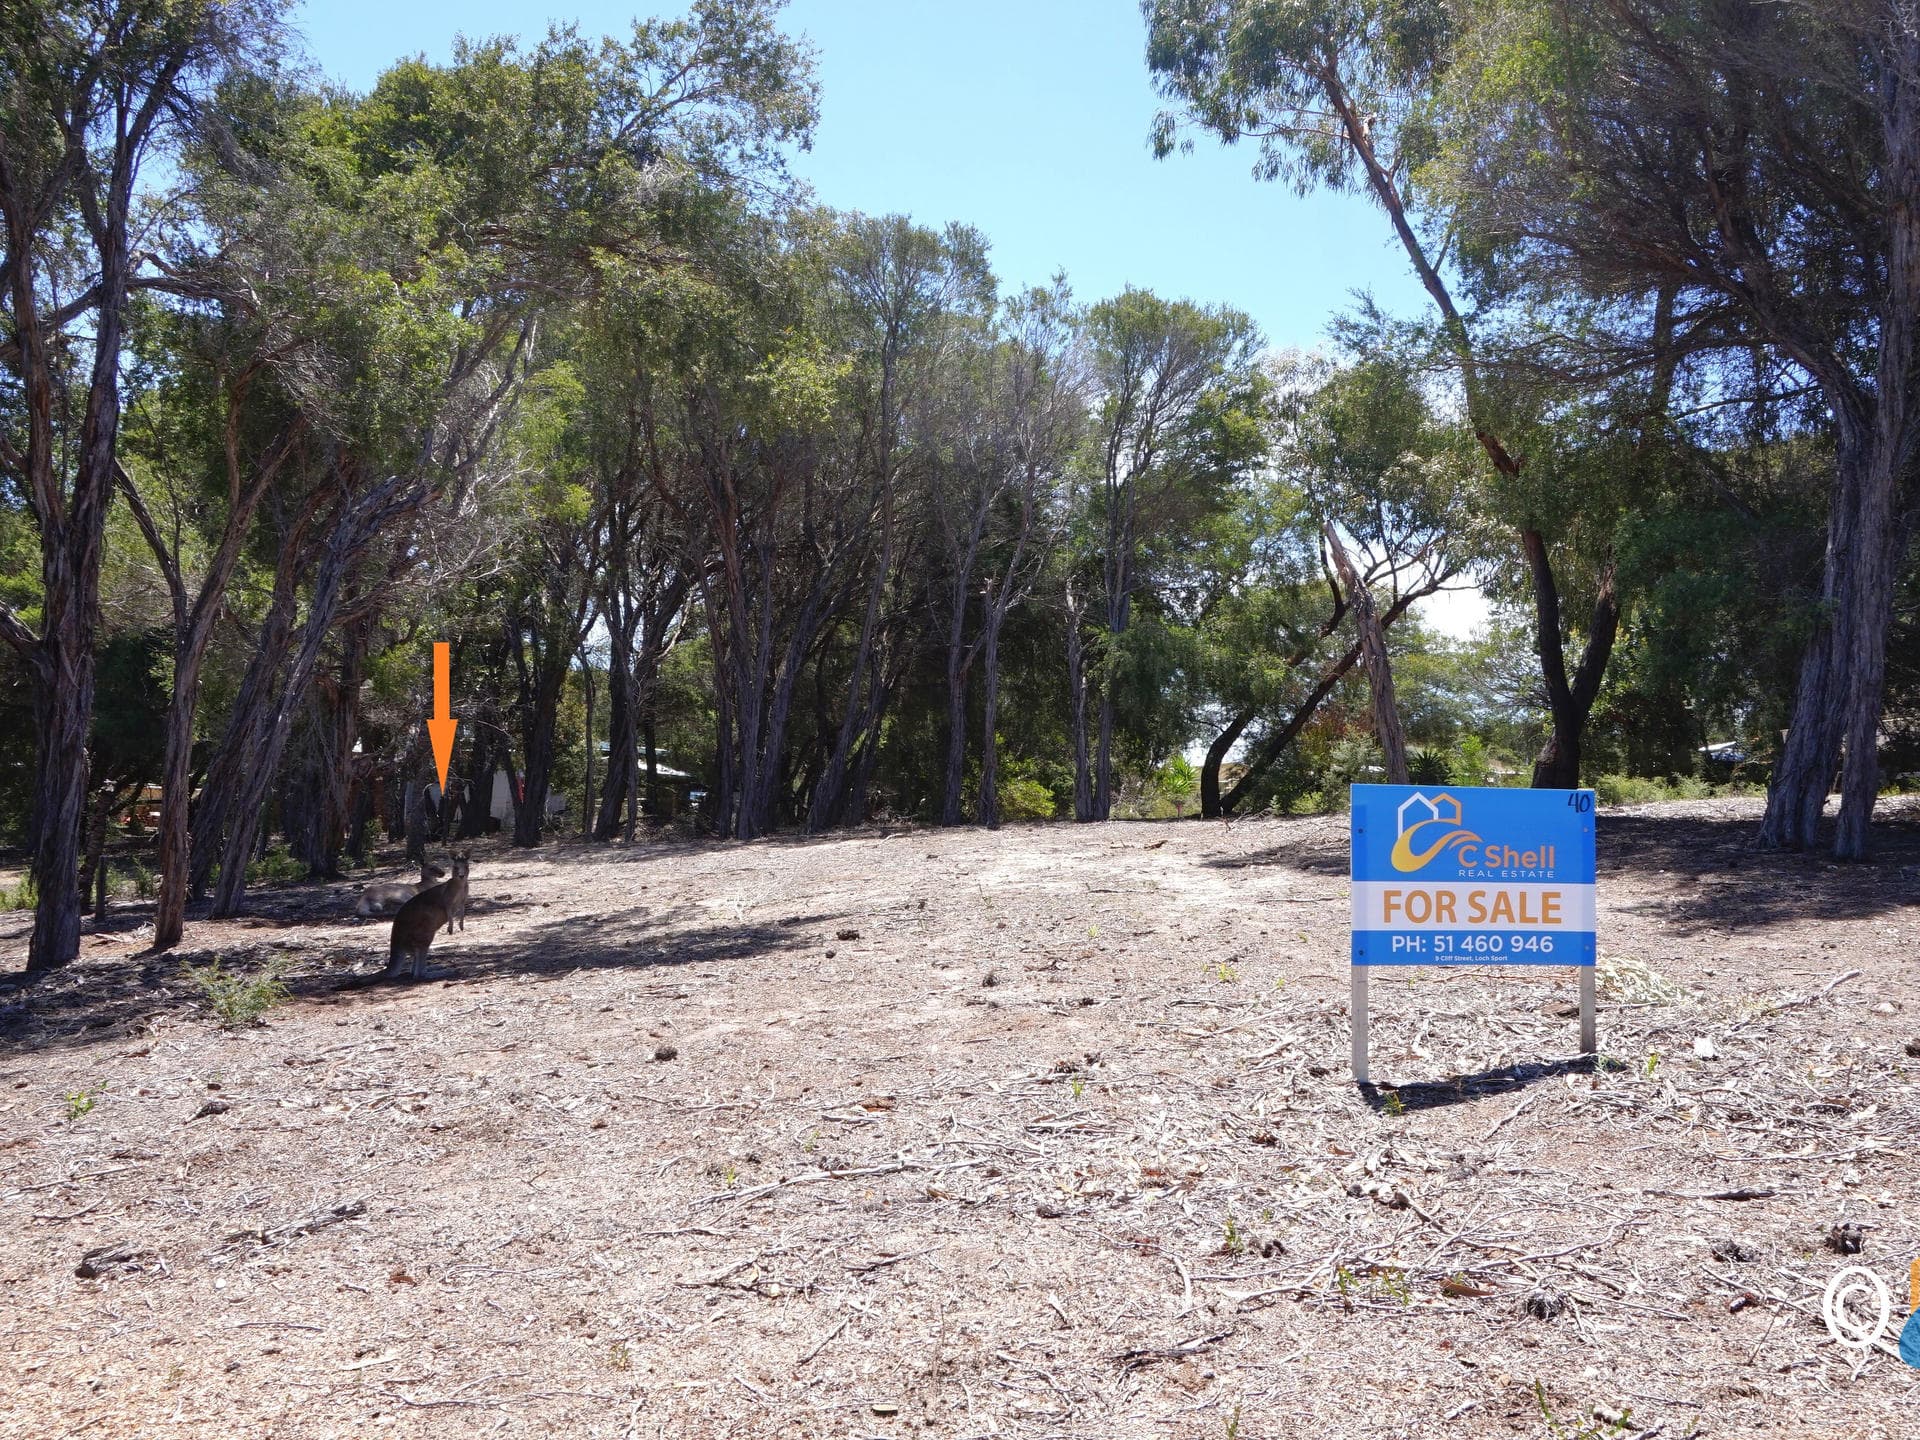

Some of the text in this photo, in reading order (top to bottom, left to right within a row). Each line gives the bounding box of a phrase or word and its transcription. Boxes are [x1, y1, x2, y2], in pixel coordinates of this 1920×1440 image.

[1567, 792, 1590, 814] 40
[1459, 845, 1555, 868] C Shell
[1502, 870, 1555, 878] ESTATE
[1383, 890, 1562, 924] FOR SALE
[1392, 936, 1554, 953] PH: 51 460 946
